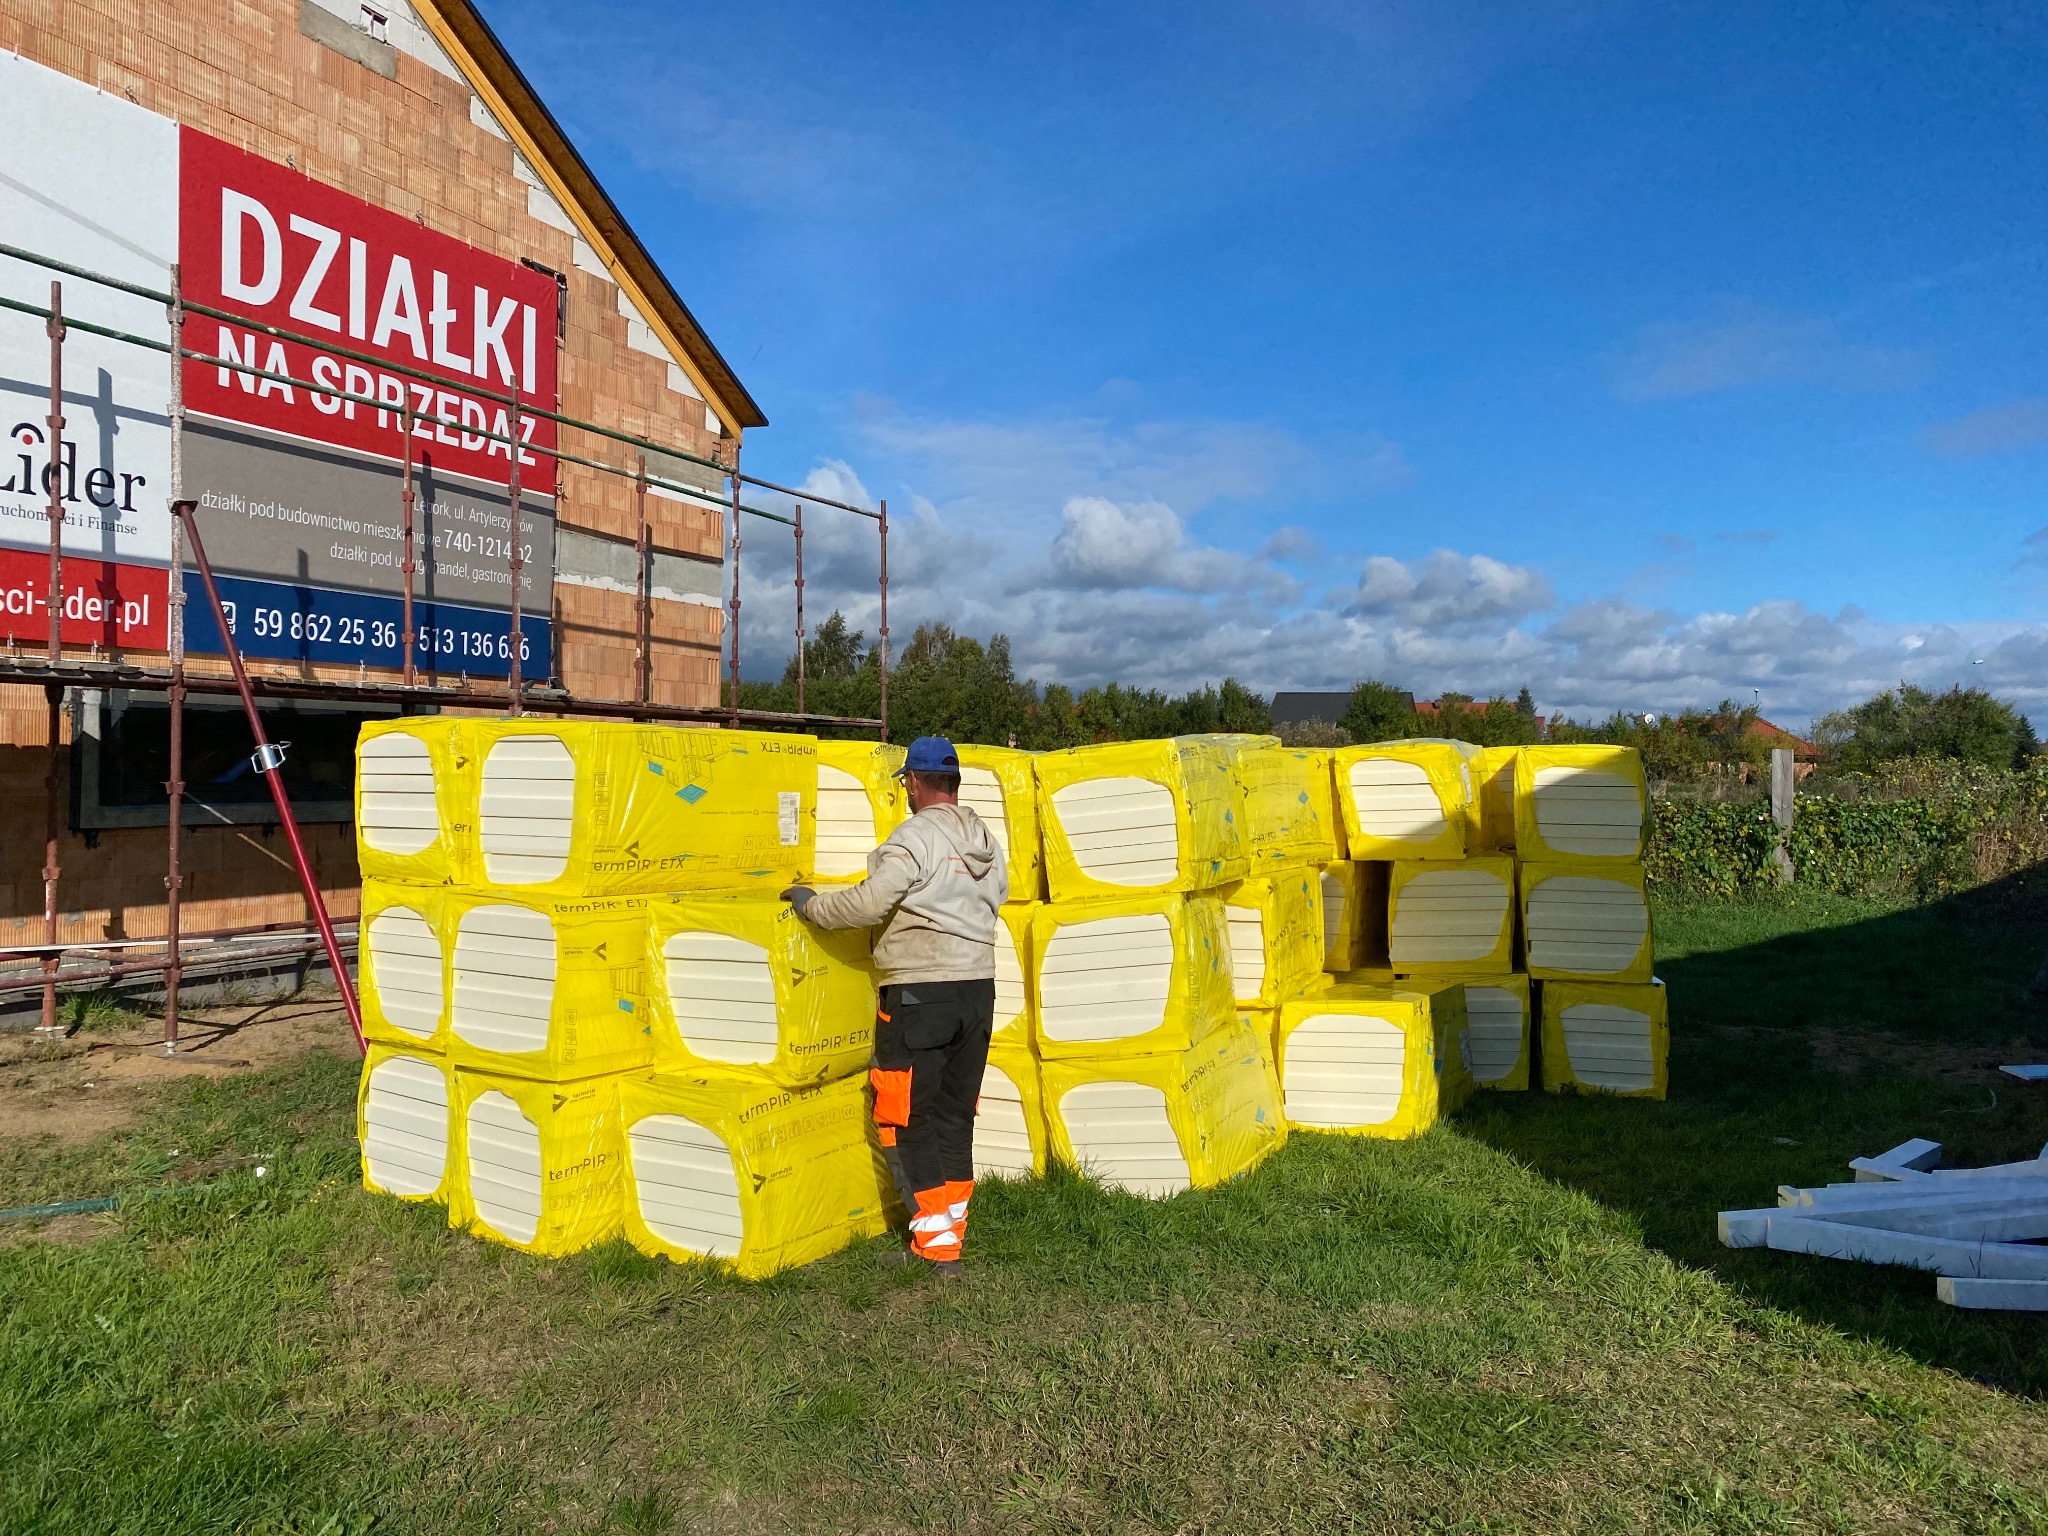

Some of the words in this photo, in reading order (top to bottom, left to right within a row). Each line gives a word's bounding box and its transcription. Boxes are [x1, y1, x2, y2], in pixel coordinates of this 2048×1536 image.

[221, 187, 536, 394] DZIAŁKI
[218, 325, 295, 405] NA
[87, 516, 138, 535] Finanse
[201, 489, 246, 513] działki
[250, 501, 274, 519] pod
[278, 503, 360, 534] budownictwo
[454, 506, 466, 521] ul.
[469, 507, 534, 533] Artylerzyów
[330, 541, 368, 563] działki
[370, 552, 392, 568] pod
[434, 557, 470, 581] handel,
[254, 607, 283, 638] 59
[290, 611, 332, 643] 862
[339, 617, 365, 646] 25
[371, 620, 397, 648] 36
[419, 624, 454, 654] 513
[460, 631, 493, 658] 136
[660, 857, 686, 870] ETX
[850, 1028, 871, 1045] ETX
[799, 1085, 823, 1101] ETX
